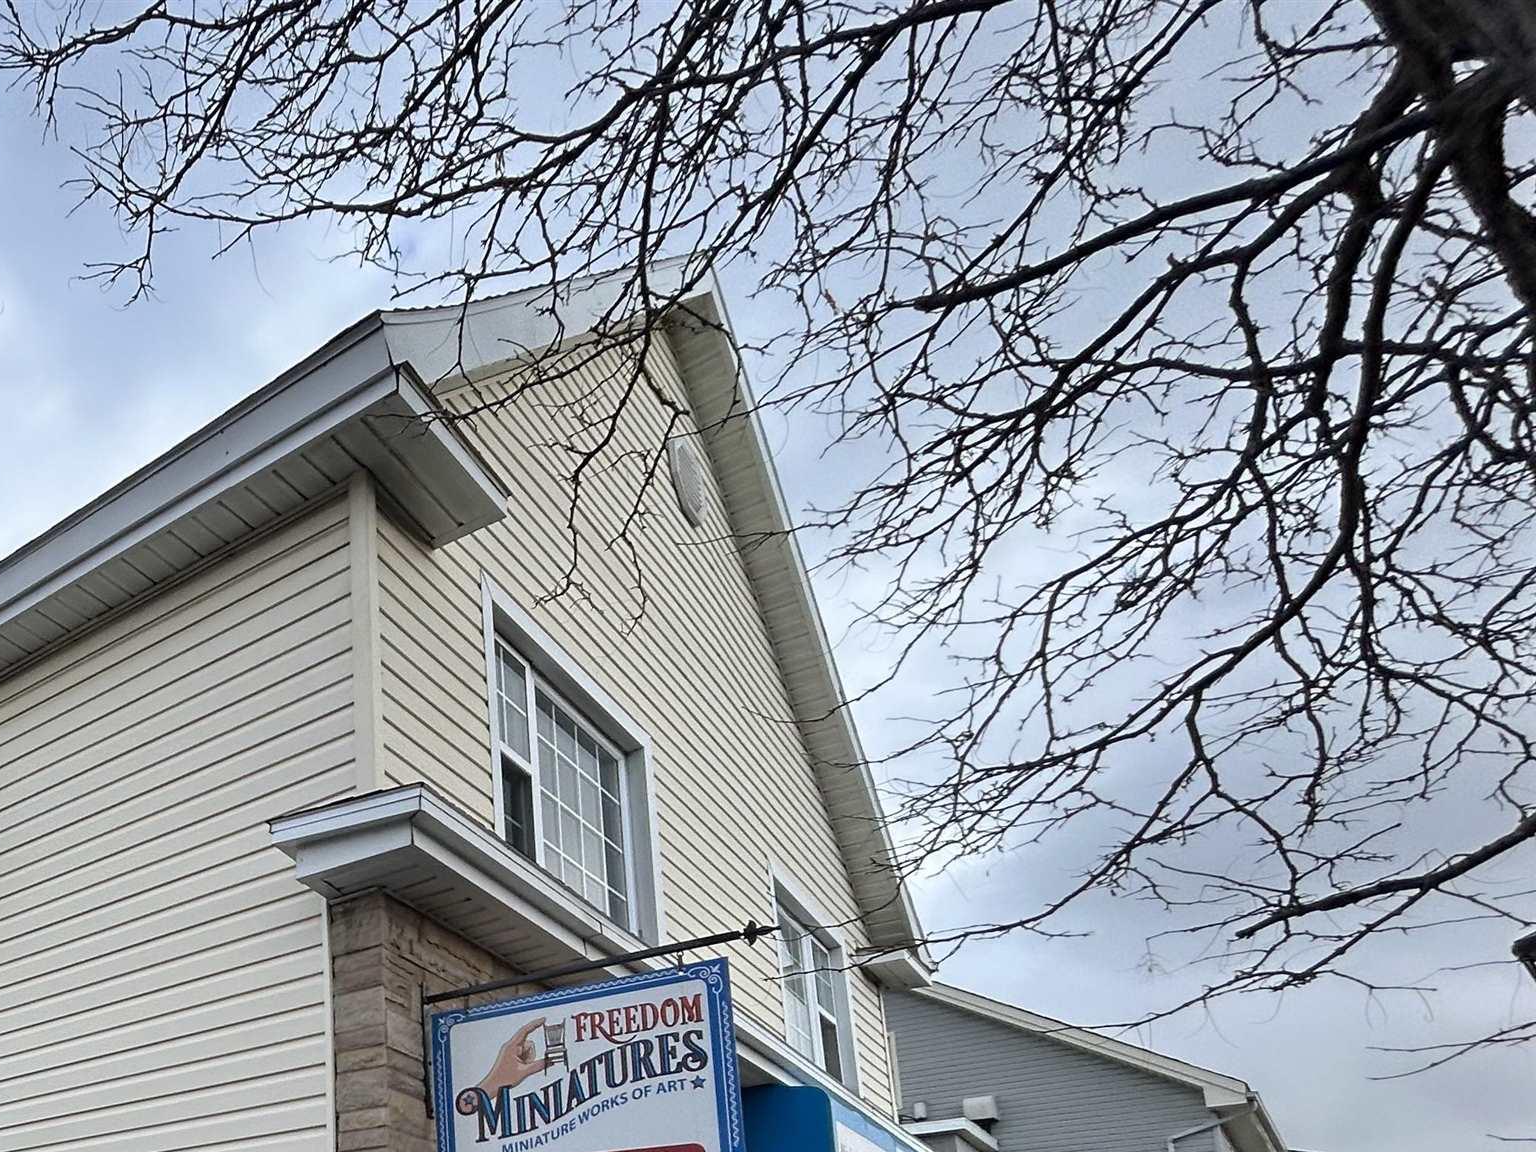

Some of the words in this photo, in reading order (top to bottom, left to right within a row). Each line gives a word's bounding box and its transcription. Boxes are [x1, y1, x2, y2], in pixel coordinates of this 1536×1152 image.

[572, 993, 705, 1044] FREEDOM
[456, 1029, 708, 1142] MINIATURES
[577, 1092, 628, 1124] WORKS
[632, 1084, 652, 1101] OF
[656, 1078, 687, 1095] ART
